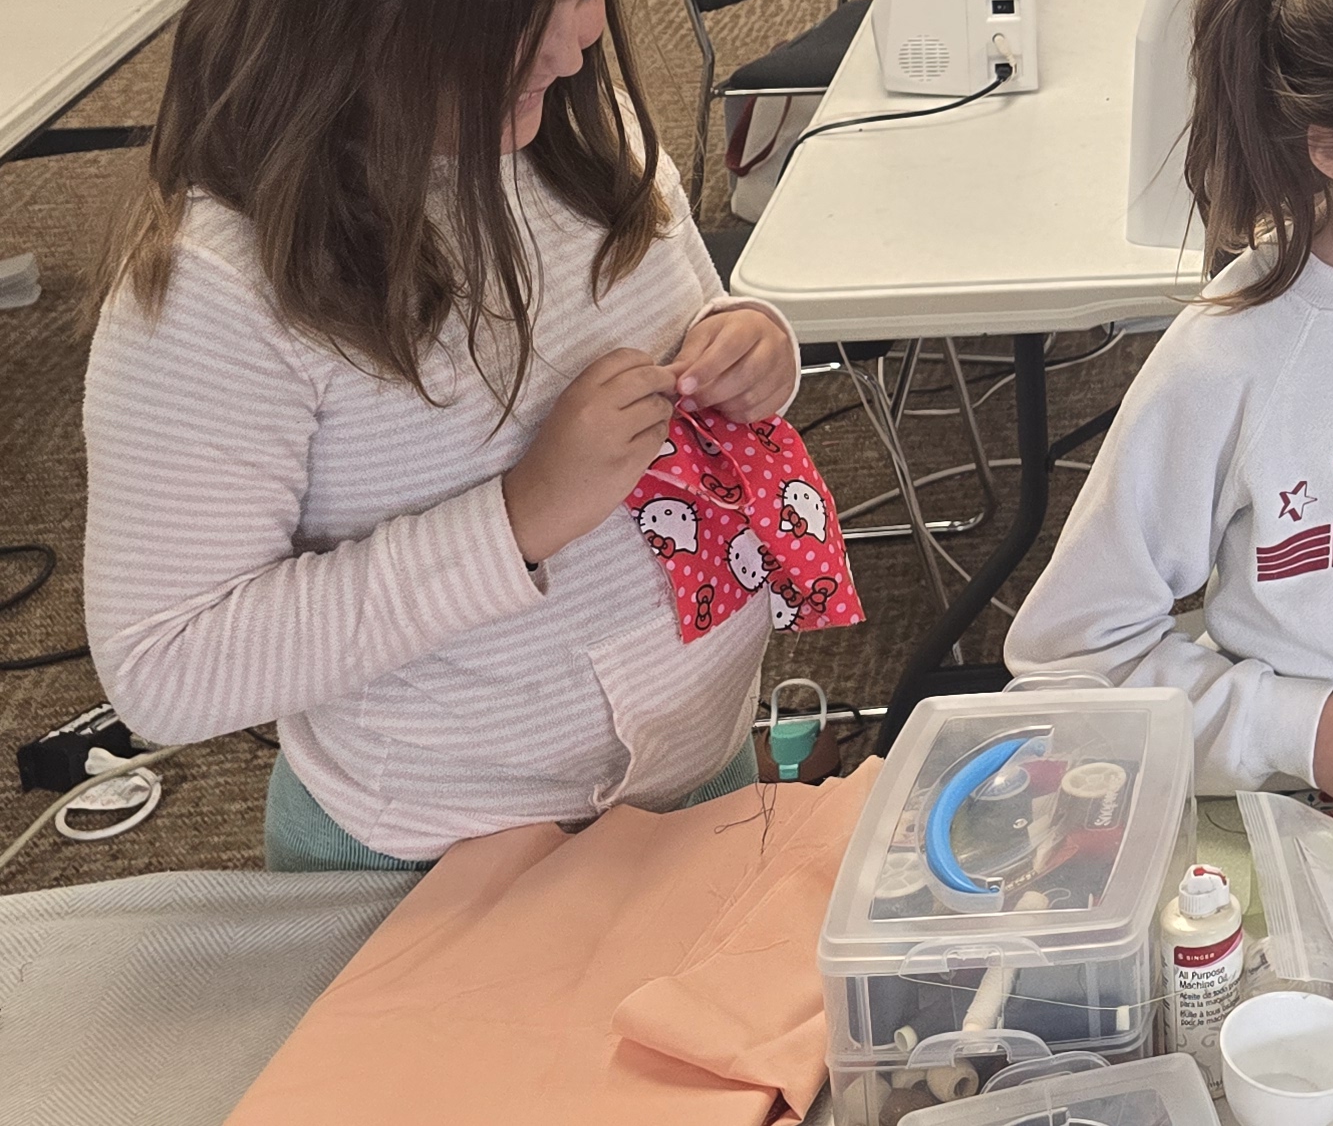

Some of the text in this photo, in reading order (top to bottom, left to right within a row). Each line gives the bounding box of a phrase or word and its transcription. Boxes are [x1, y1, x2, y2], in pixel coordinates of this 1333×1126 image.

[1186, 953, 1215, 961] SINGER
[1179, 967, 1225, 980] All Purpose
[1180, 980, 1215, 989] Machine
